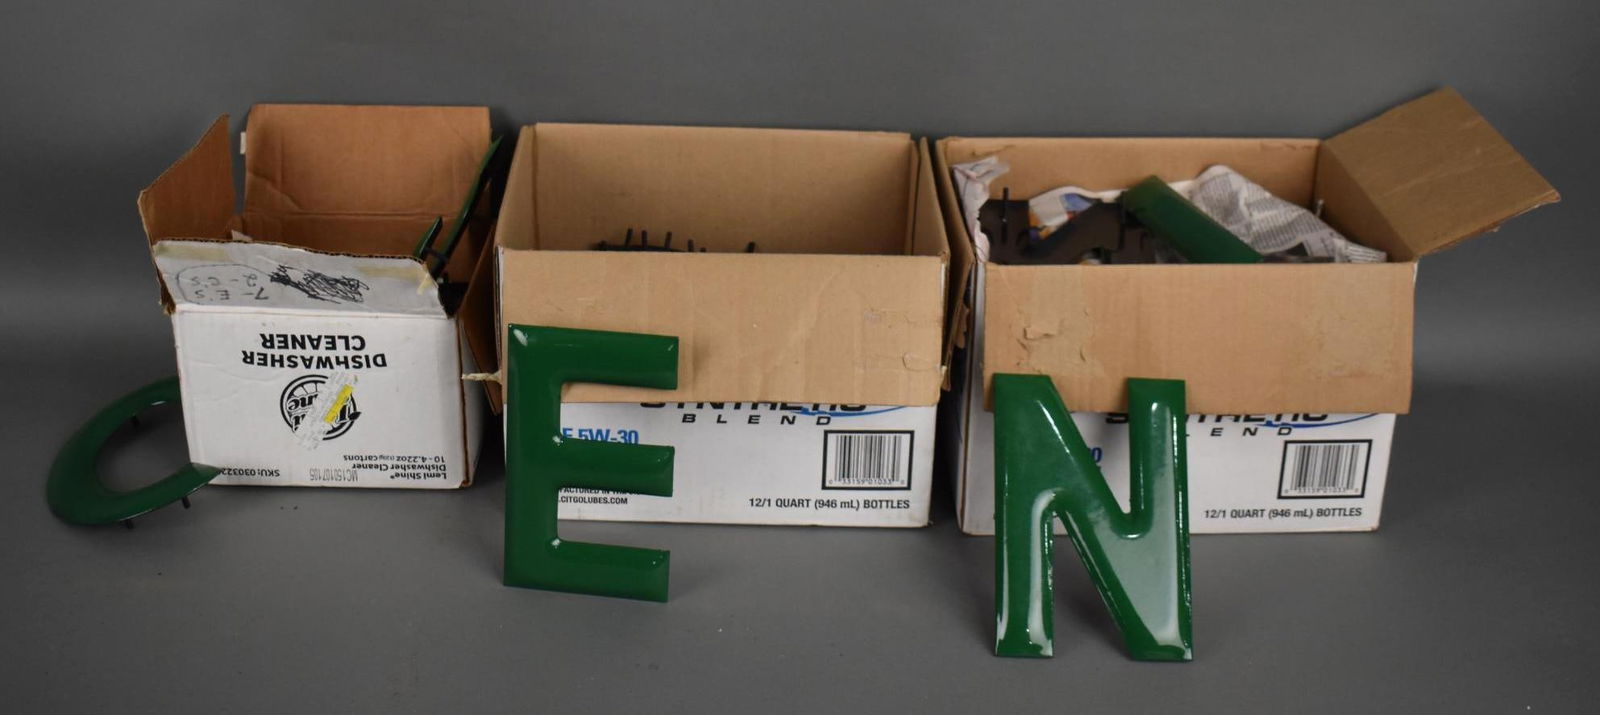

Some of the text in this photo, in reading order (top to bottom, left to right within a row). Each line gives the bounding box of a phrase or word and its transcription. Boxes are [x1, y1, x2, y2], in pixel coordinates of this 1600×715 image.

[260, 333, 366, 351] CLEANER
[242, 350, 388, 370] DISHWASHER
[682, 413, 832, 426] BLEND
[343, 454, 378, 462] cartons
[503, 323, 679, 602] E
[257, 468, 281, 478] SKU:
[352, 463, 446, 472] Dishwasher Cleaner
[424, 472, 447, 480] Lemi
[749, 498, 910, 511] 12/1 QUART (946 mL) BOTTLES
[993, 373, 1192, 661] N
[1204, 507, 1363, 520] 12/1 QUART (946 mL) BOTTLES
